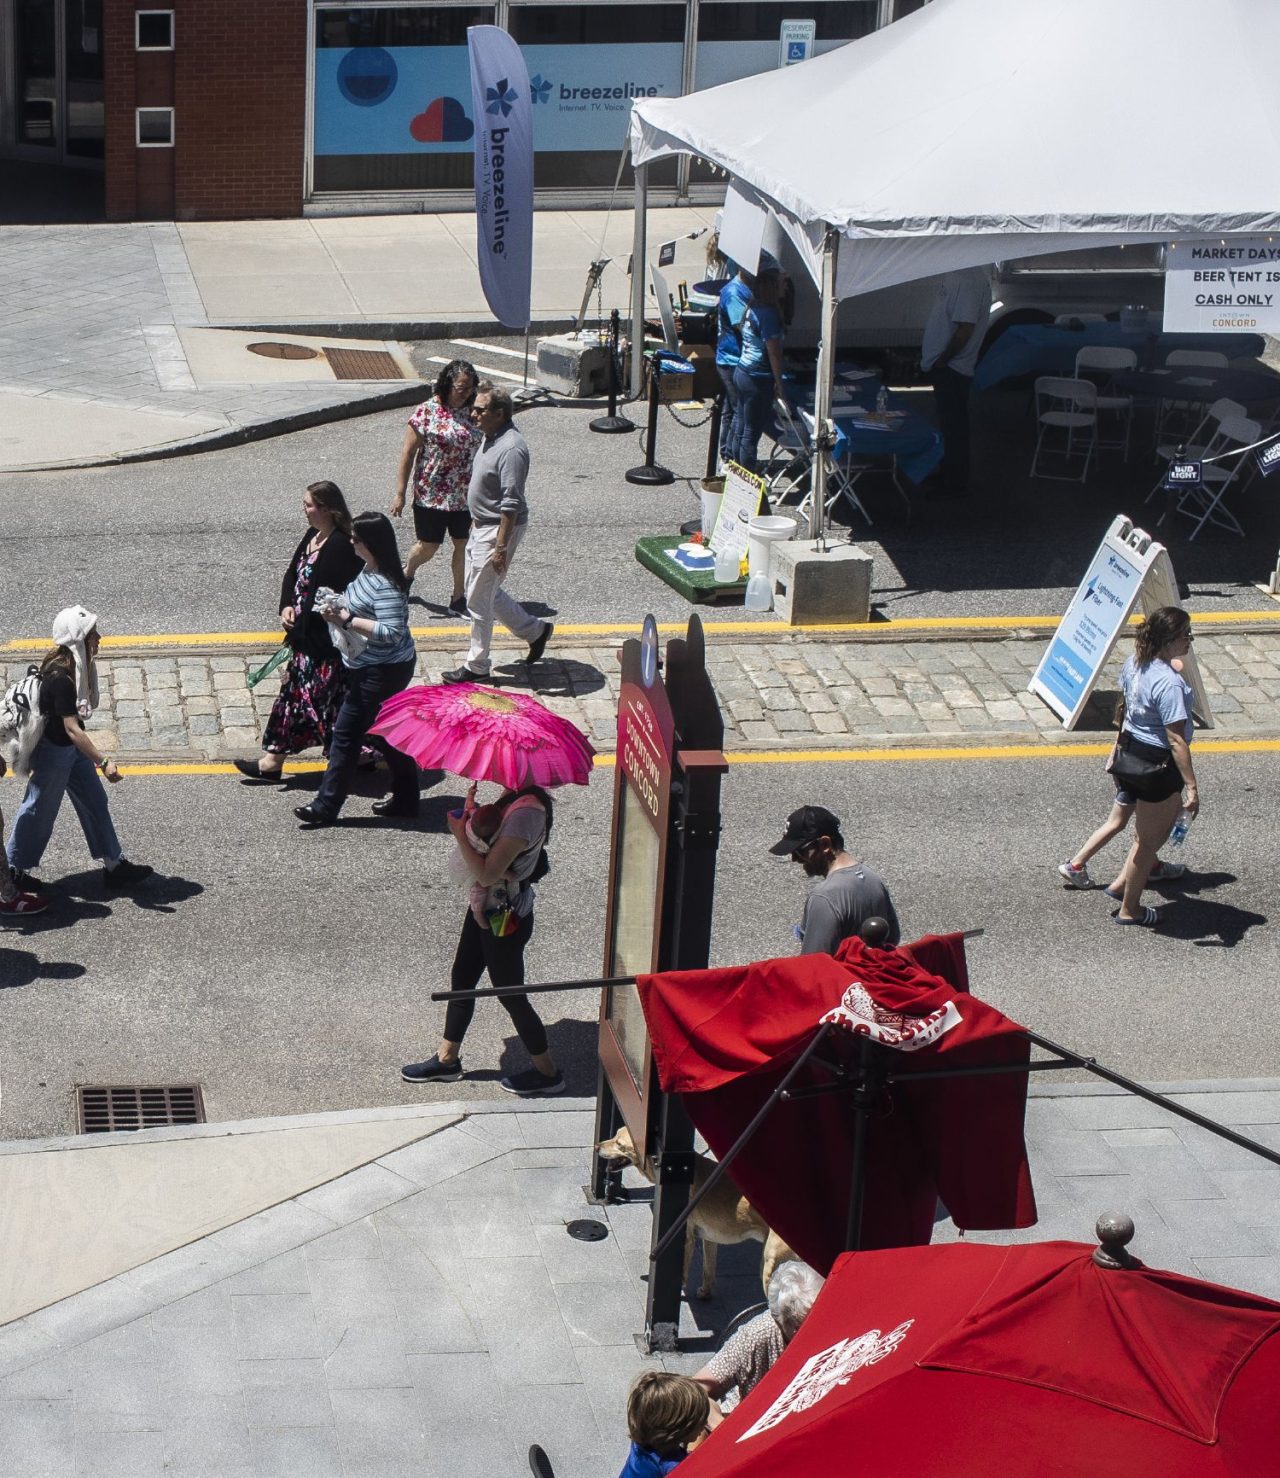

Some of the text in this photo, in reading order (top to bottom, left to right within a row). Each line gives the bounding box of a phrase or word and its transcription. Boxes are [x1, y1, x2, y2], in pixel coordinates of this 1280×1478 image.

[491, 127, 510, 254] breezeline
[1191, 248, 1245, 259] MARKET
[1193, 271, 1280, 282] BEER TENT IS
[1195, 294, 1273, 305] CASH ONLY
[1212, 319, 1257, 328] CONCORD
[1174, 465, 1194, 473] BUD
[1170, 471, 1198, 479] LIGHT
[626, 717, 660, 788] DOWNTOWN
[624, 743, 659, 817] CONCORD
